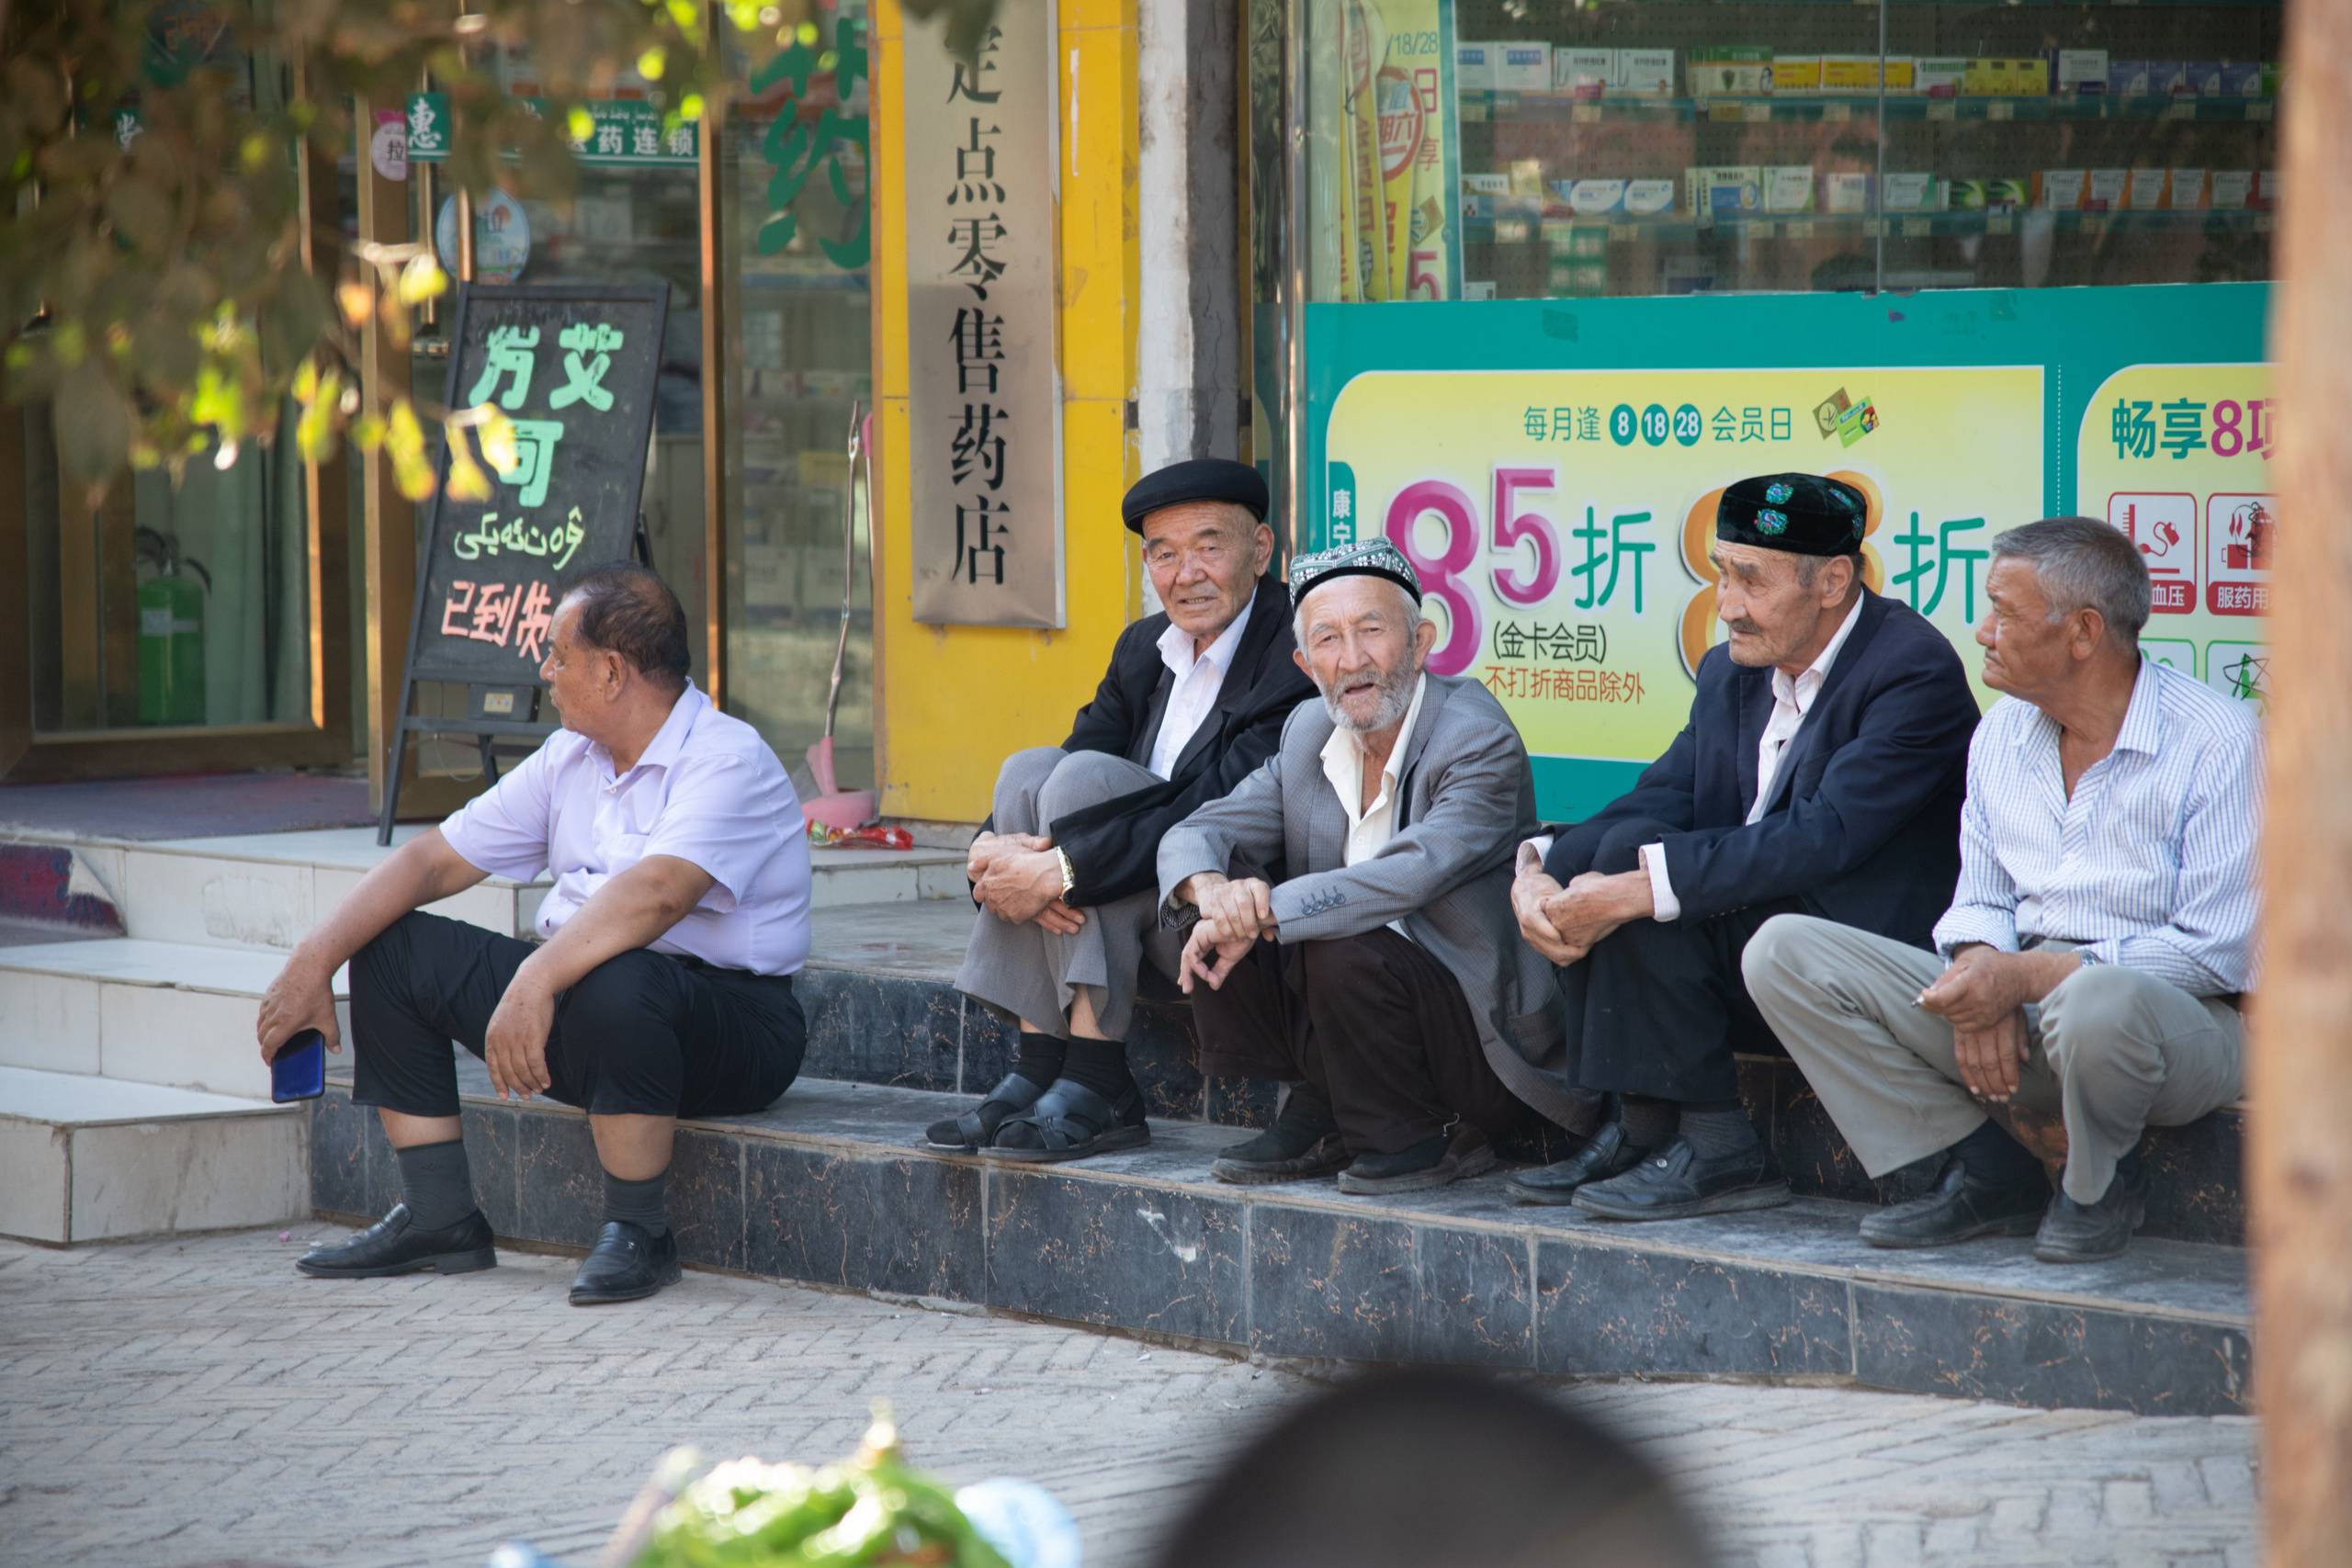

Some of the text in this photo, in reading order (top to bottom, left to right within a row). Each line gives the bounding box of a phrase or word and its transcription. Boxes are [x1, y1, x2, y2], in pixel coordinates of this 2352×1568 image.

[1523, 405, 1791, 442] 每月逢 8 18 28 会员日
[1494, 620, 1607, 664] (金卡会员)
[1485, 666, 1645, 705] 不打折商品除外
